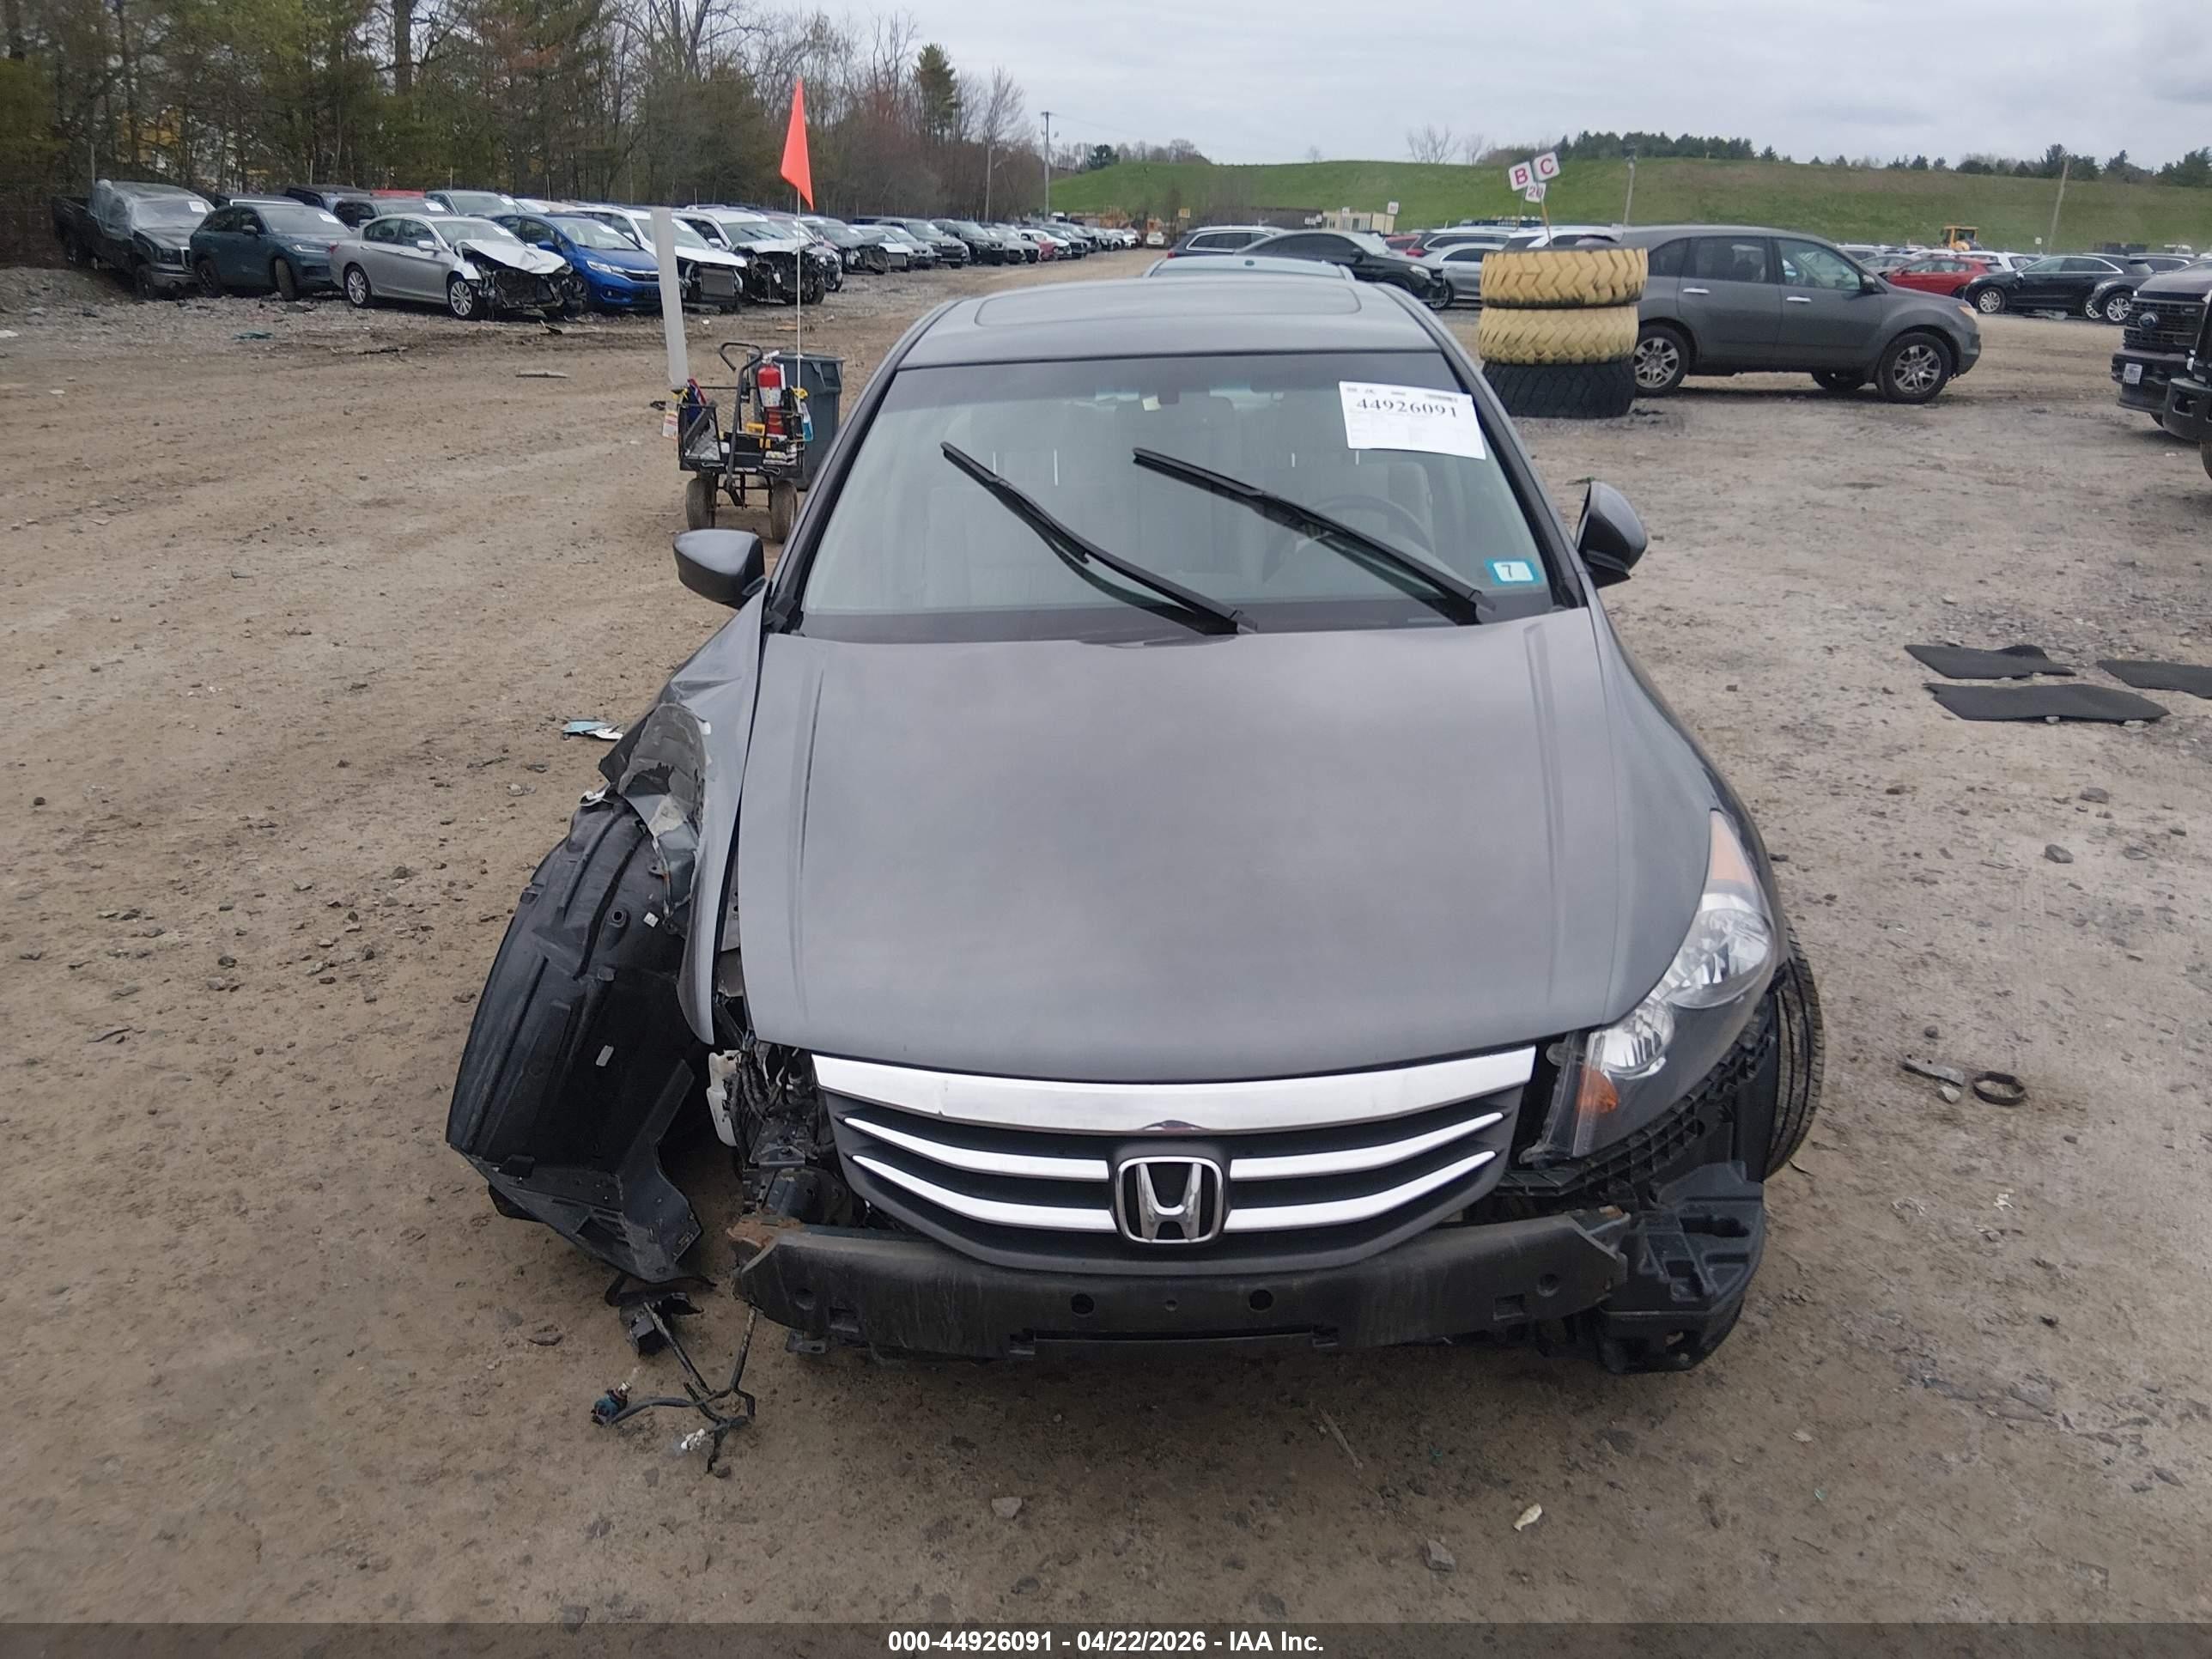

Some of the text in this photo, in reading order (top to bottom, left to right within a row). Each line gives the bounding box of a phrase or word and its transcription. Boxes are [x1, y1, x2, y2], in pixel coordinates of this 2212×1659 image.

[1515, 158, 1554, 185] B C
[1356, 398, 1458, 418] 44926091
[1501, 564, 1513, 578] 7
